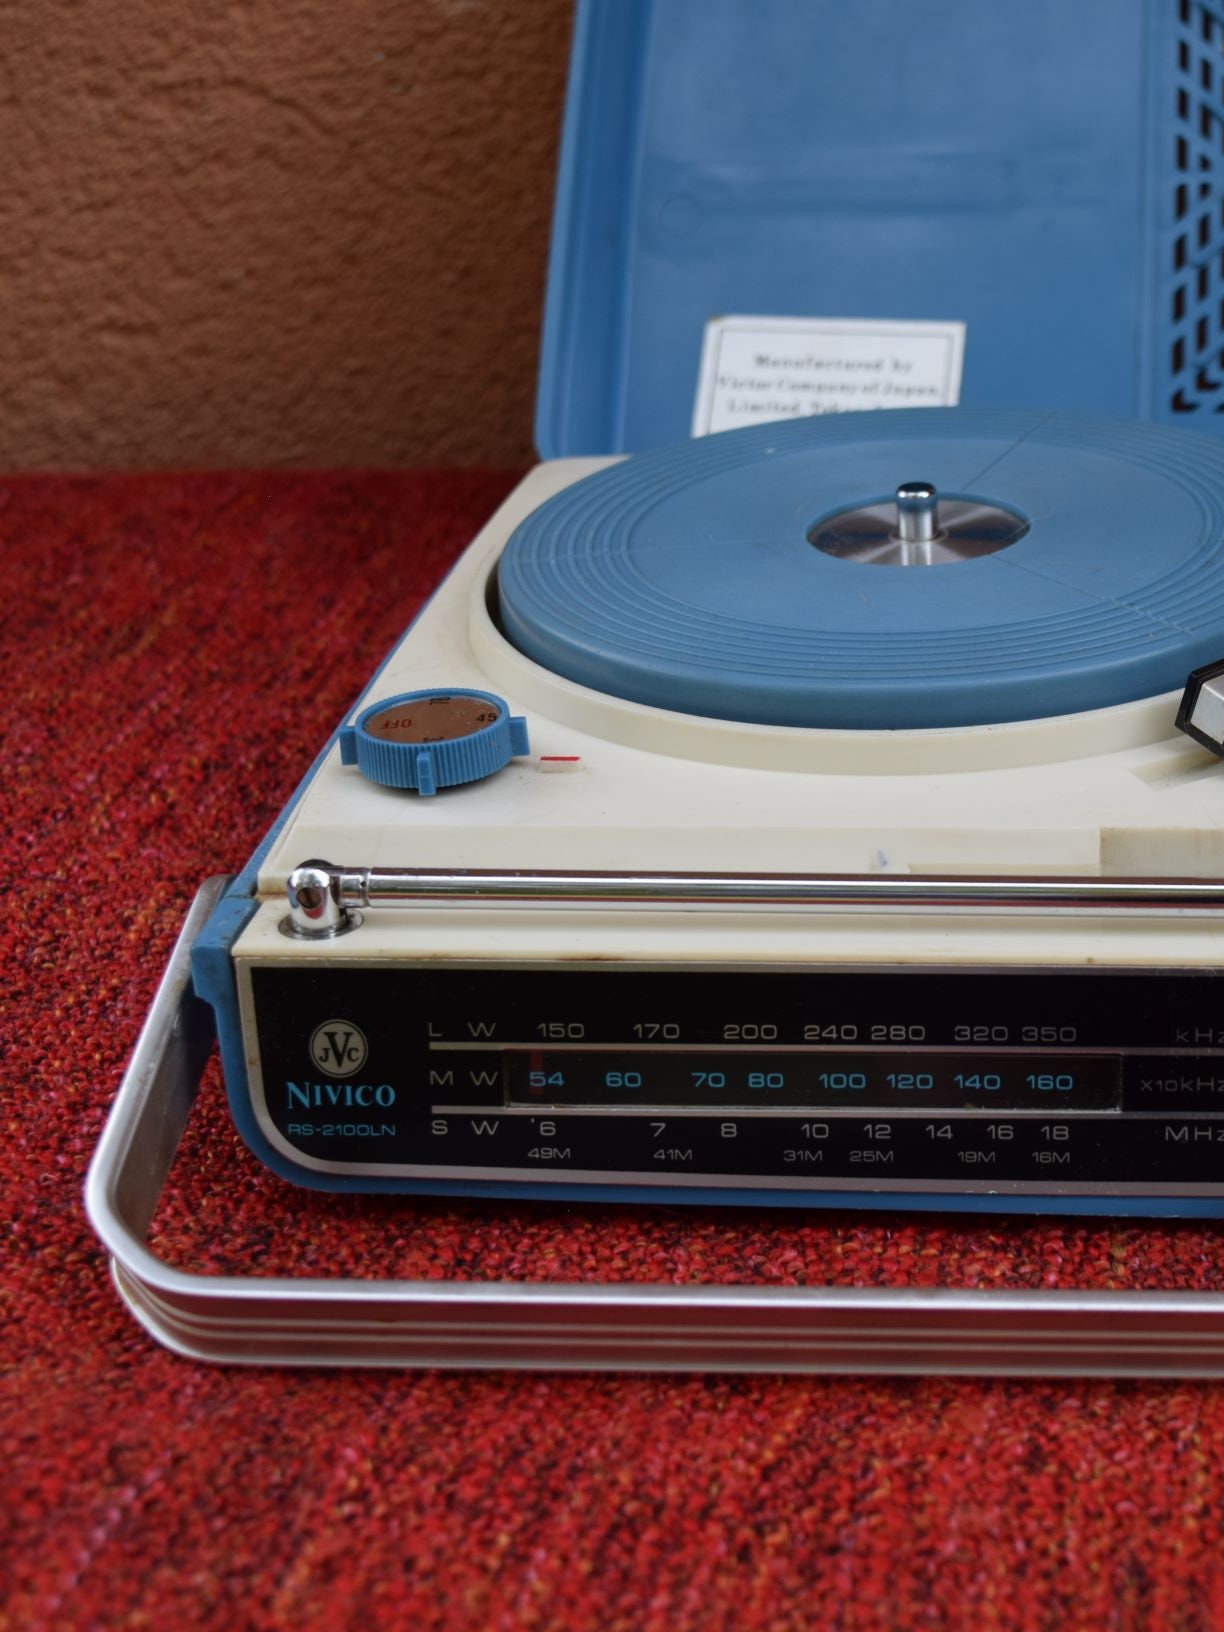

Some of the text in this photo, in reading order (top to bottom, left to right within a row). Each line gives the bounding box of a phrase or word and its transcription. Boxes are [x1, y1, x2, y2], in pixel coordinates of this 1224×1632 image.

[755, 355, 912, 375] Manufactured by
[776, 378, 856, 395] Company
[861, 381, 880, 393] of
[381, 719, 412, 730] OFF
[476, 713, 498, 723] 45
[537, 1022, 585, 1039] 150
[633, 1023, 680, 1039] 170
[723, 1024, 778, 1040] 200
[803, 1024, 858, 1041] 240
[870, 1024, 926, 1041] 280
[954, 1025, 1009, 1042] 320
[1021, 1025, 1077, 1043] 350
[319, 1031, 360, 1069] JVC
[529, 1071, 565, 1087] 54
[605, 1071, 642, 1088] 60
[691, 1072, 726, 1088] 70
[747, 1072, 784, 1089] 80
[818, 1073, 867, 1089] 100
[886, 1073, 934, 1090] 120
[953, 1074, 1001, 1090] 140
[1026, 1074, 1073, 1091] 160
[286, 1081, 396, 1109] NIVICO
[287, 1123, 396, 1137] RS-2100LN
[539, 1121, 557, 1137] 6
[649, 1122, 667, 1137] 7
[720, 1122, 738, 1138] 8
[800, 1123, 829, 1139] 10
[863, 1123, 892, 1140] 12
[925, 1124, 954, 1140] 14
[986, 1124, 1014, 1140] 16
[1040, 1125, 1070, 1141] 18
[527, 1147, 1071, 1164] 49M 41M 31M 25M 19M 16M
